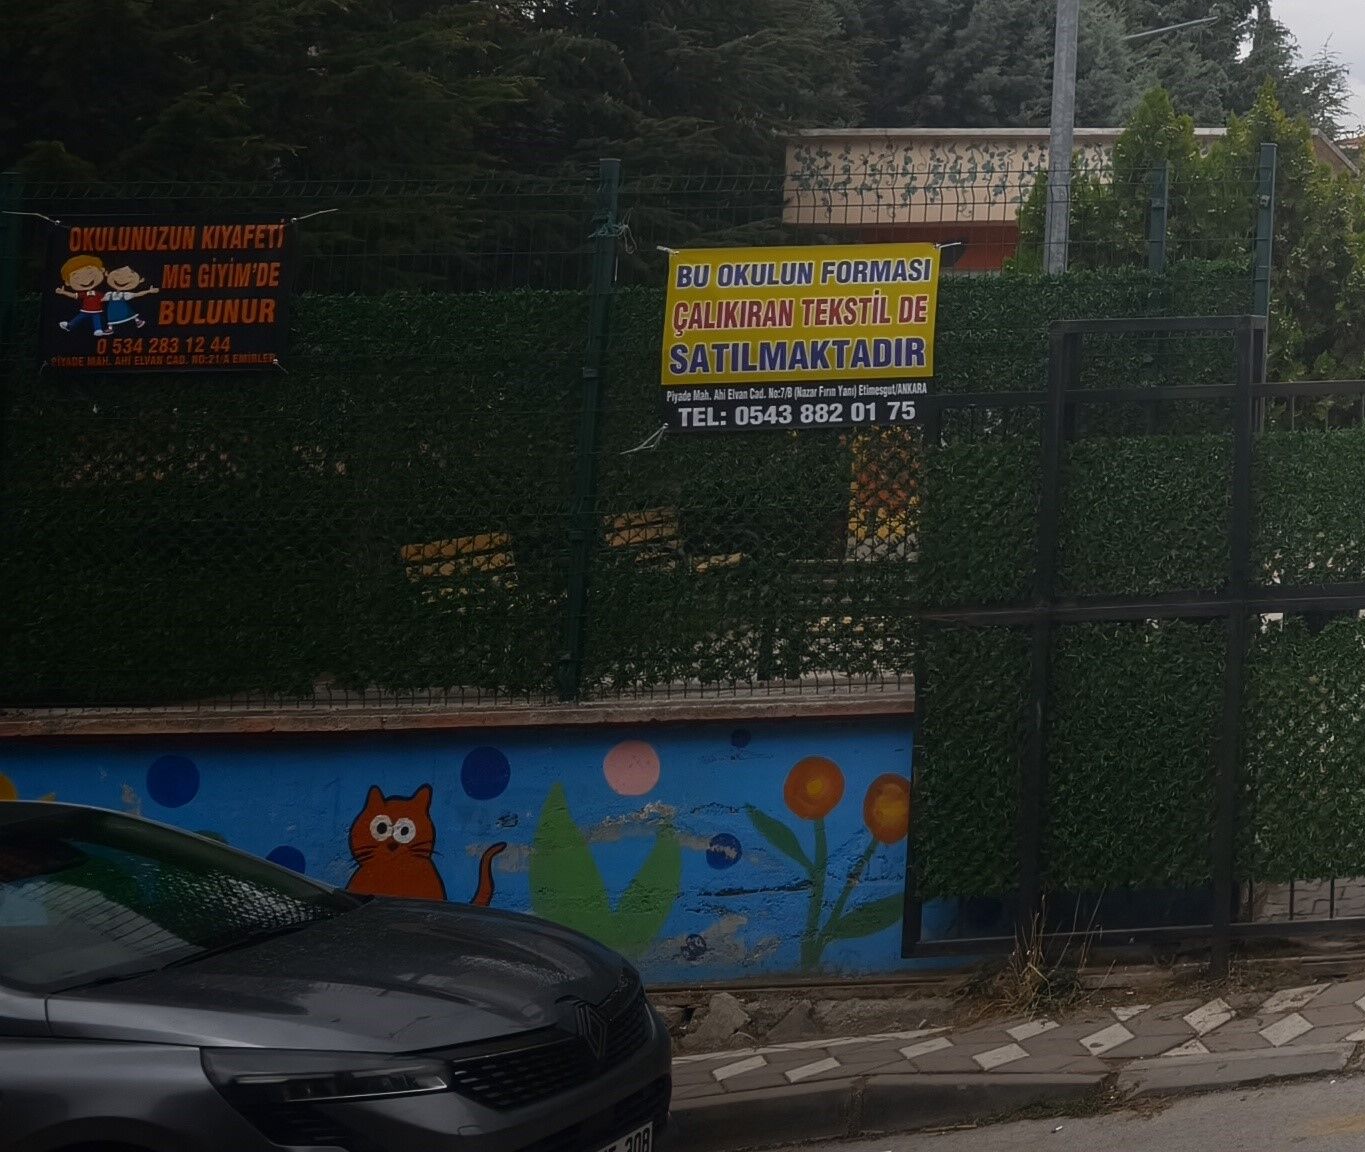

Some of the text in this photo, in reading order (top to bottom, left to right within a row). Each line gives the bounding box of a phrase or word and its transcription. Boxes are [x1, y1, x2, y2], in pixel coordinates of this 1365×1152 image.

[69, 219, 286, 252] OKULUNUZUN KIYAFETİ
[162, 263, 191, 288] MG
[676, 258, 931, 288] BU OKULUN FORMASI
[159, 298, 276, 325] BULUNUR
[673, 289, 928, 337] ÇALIKIRAN TEKSTİL DE
[97, 336, 231, 354] 0 534 283 12 44
[669, 337, 925, 374] SATILMAKTADIR
[667, 390, 692, 403] Piyade
[728, 388, 748, 400] Elvan
[678, 401, 916, 427] TEL: 0543 882 01 75
